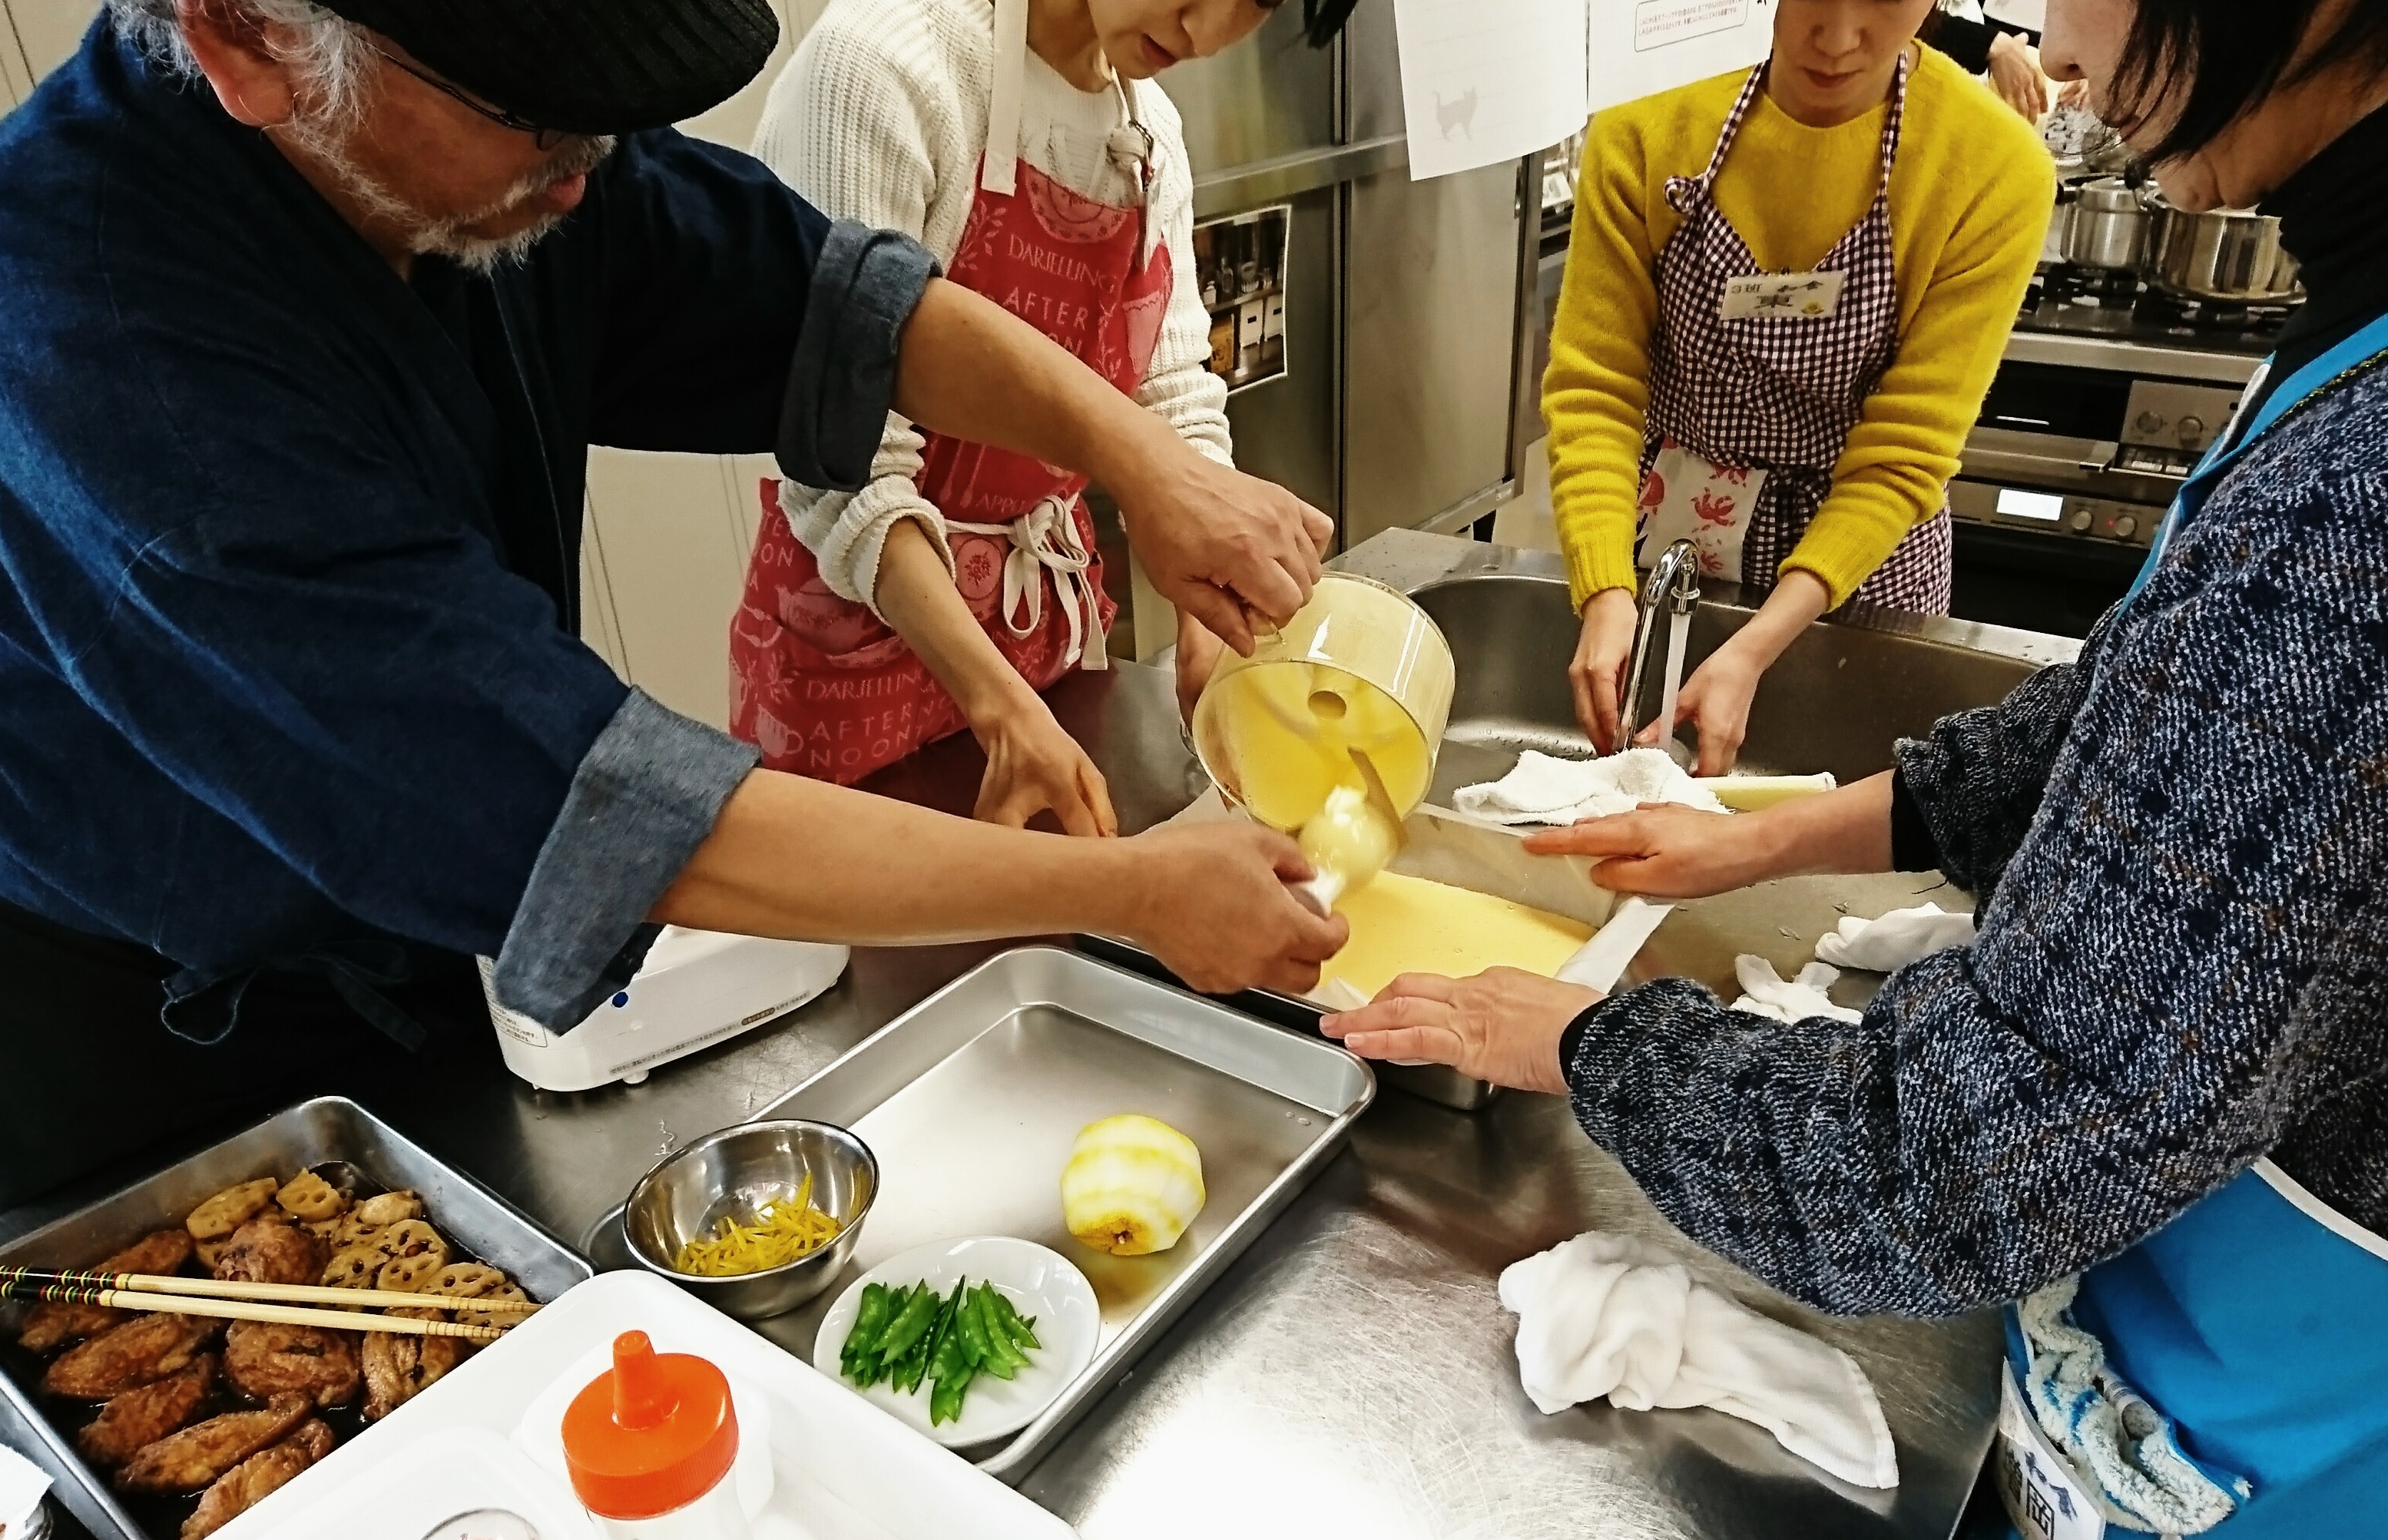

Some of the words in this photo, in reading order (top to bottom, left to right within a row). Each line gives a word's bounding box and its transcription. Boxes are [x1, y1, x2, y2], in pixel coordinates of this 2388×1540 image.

[1002, 286, 1089, 331] AFTER
[809, 702, 912, 742] AFTER
[810, 724, 911, 768] NOON
